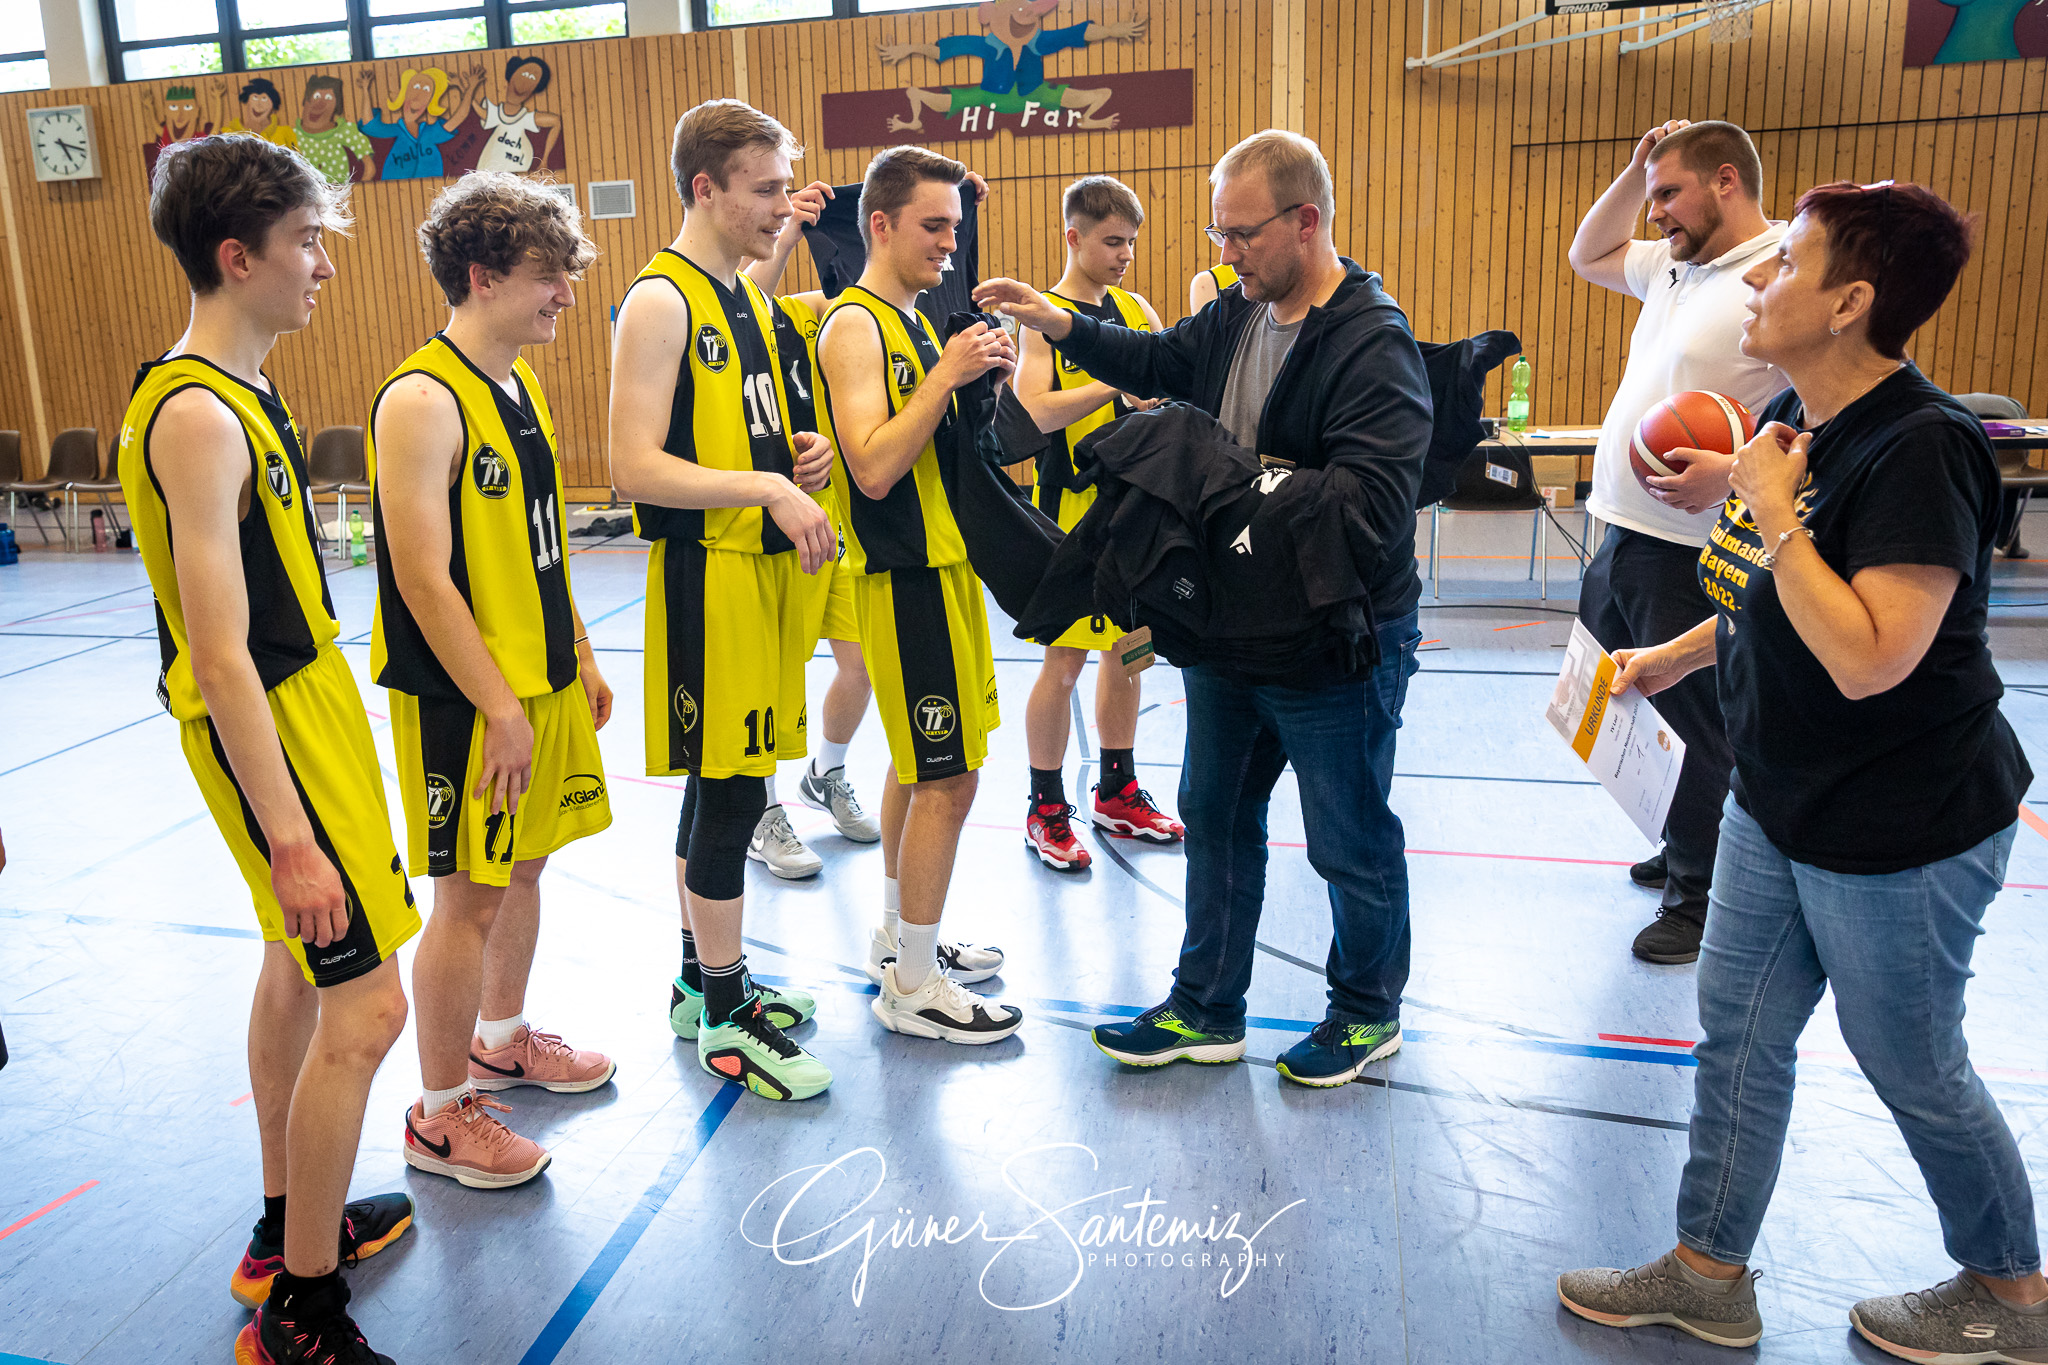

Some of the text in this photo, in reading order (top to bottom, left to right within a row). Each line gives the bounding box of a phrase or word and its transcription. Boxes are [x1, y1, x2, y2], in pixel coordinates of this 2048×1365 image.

[1557, 3, 1609, 15] ERHARD
[960, 102, 997, 132] Hi
[391, 144, 433, 168] hallo
[497, 132, 522, 149] doch
[504, 152, 525, 166] mal
[743, 372, 782, 438] 10
[532, 493, 561, 572] 11
[1710, 518, 1773, 571] inimaste
[1699, 544, 1750, 589] Bayern
[1584, 676, 1610, 737] URKUNDE
[744, 706, 777, 758] 10
[558, 783, 606, 809] AKGlanz
